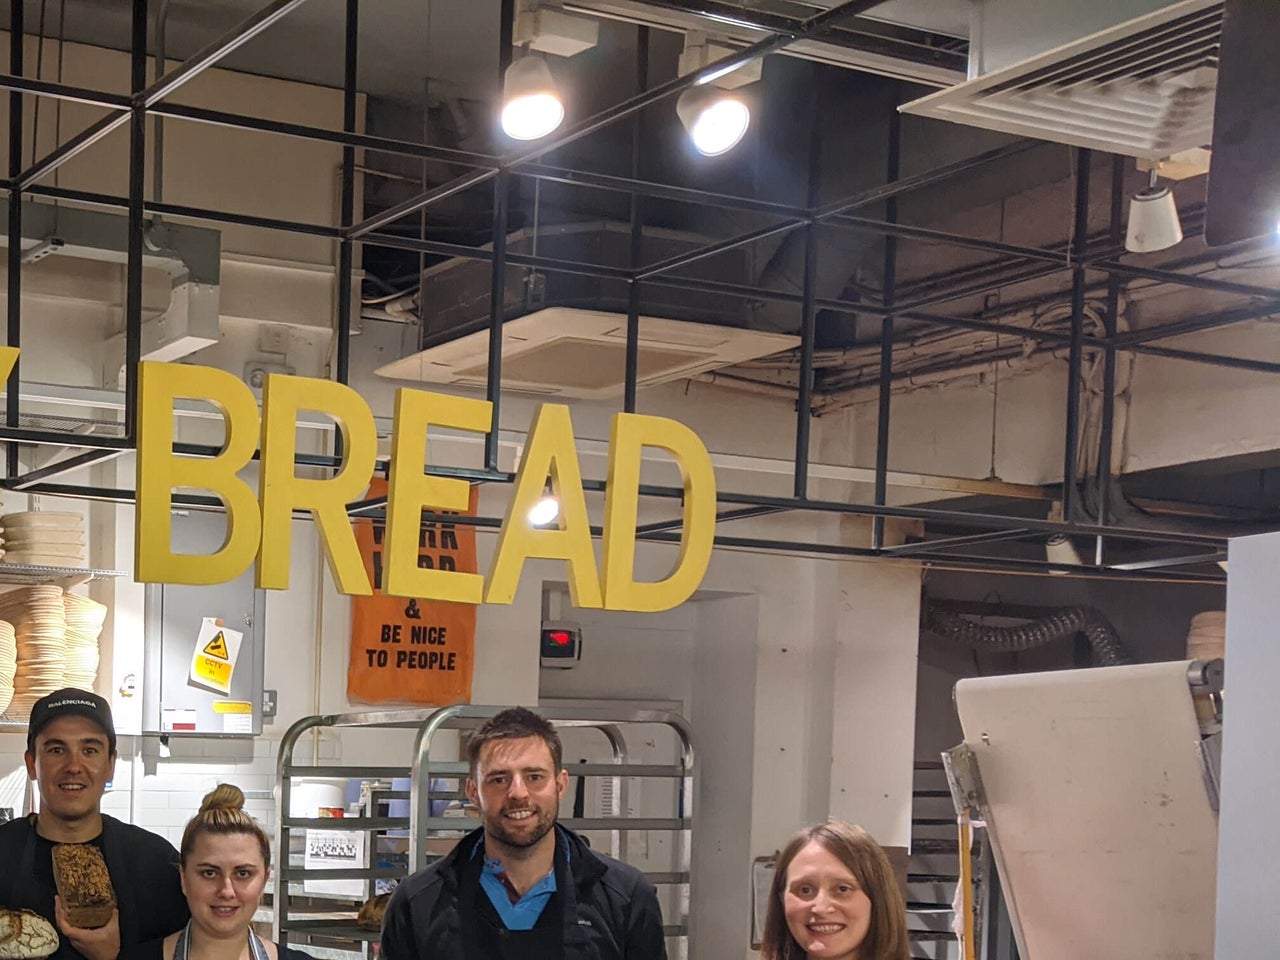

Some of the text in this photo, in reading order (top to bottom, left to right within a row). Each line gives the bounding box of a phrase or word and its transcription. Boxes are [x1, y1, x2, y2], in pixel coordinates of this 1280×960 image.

[135, 361, 717, 613] BREAD
[404, 599, 421, 619] &
[381, 625, 447, 645] BE NICE
[205, 658, 224, 670] CCTV
[366, 649, 457, 670] TO PEOPLE
[48, 699, 97, 708] BALENCIAGA
